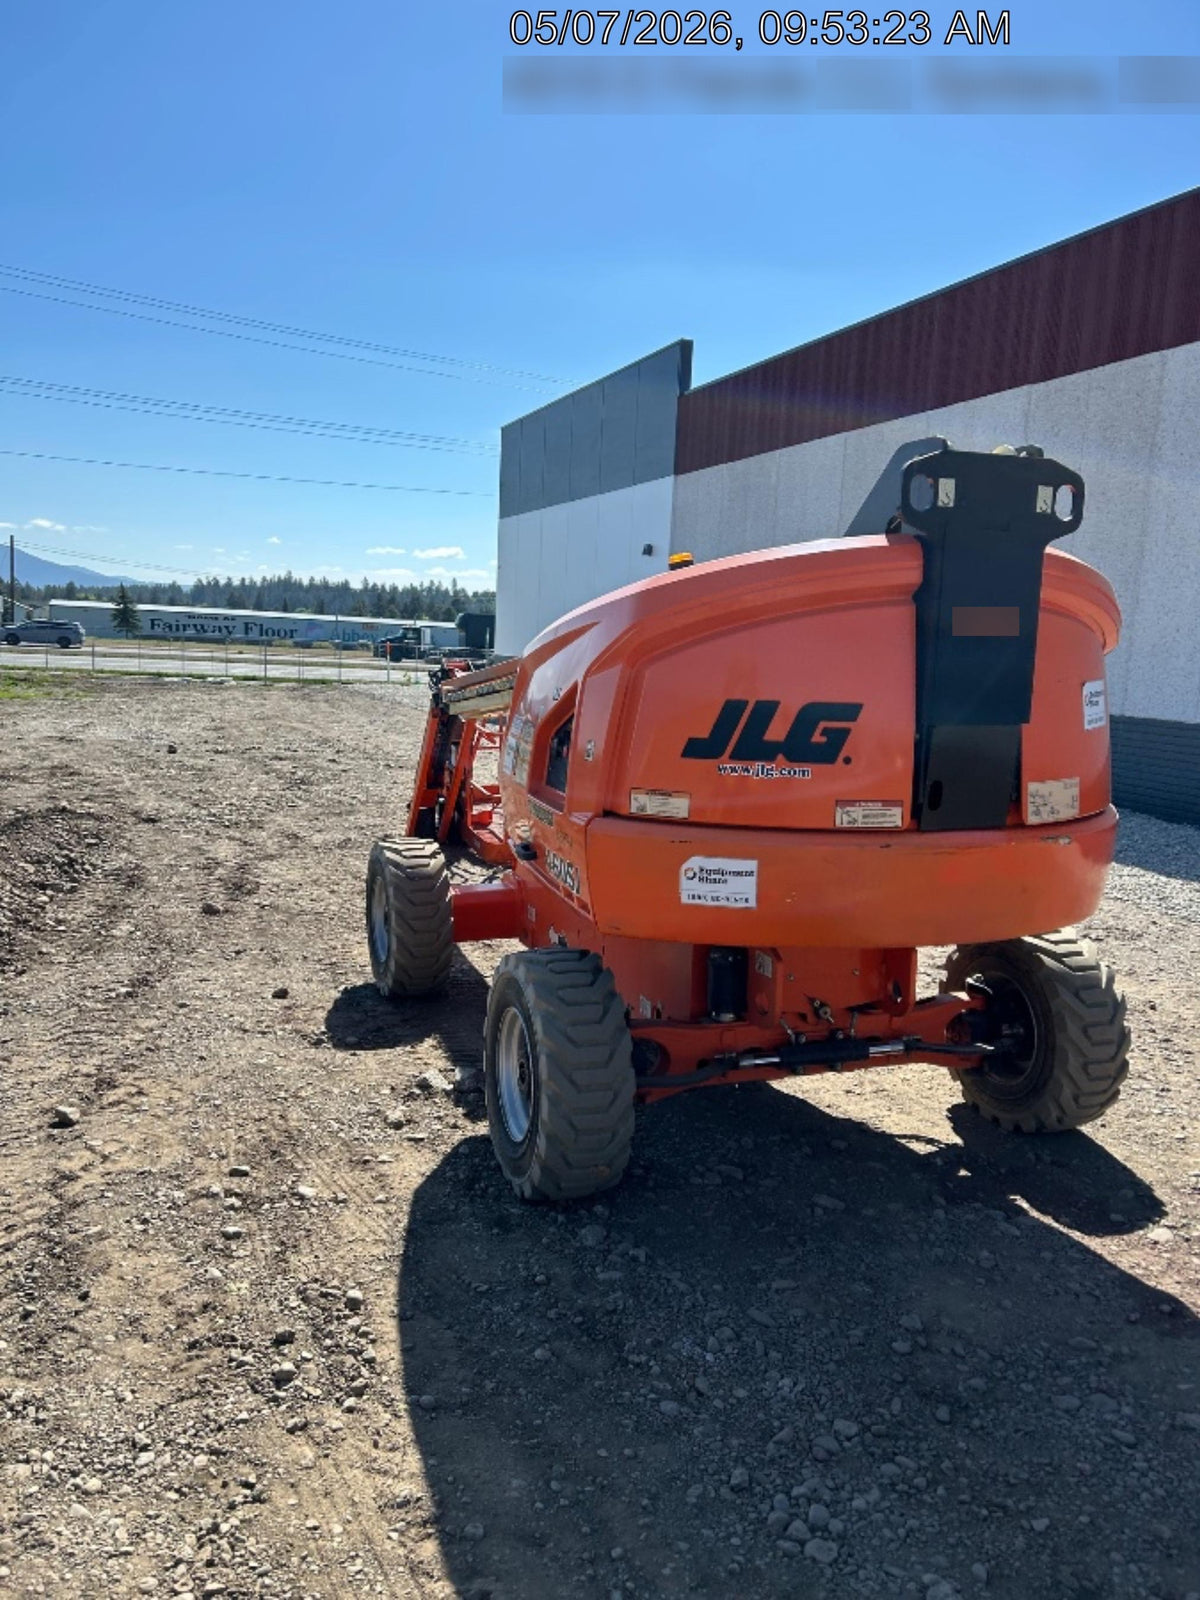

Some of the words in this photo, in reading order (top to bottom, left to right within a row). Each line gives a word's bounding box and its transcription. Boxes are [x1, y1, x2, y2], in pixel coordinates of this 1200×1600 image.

[149, 618, 236, 637] Fairway
[243, 621, 299, 639] Floor
[717, 763, 811, 779] www.jlg.com
